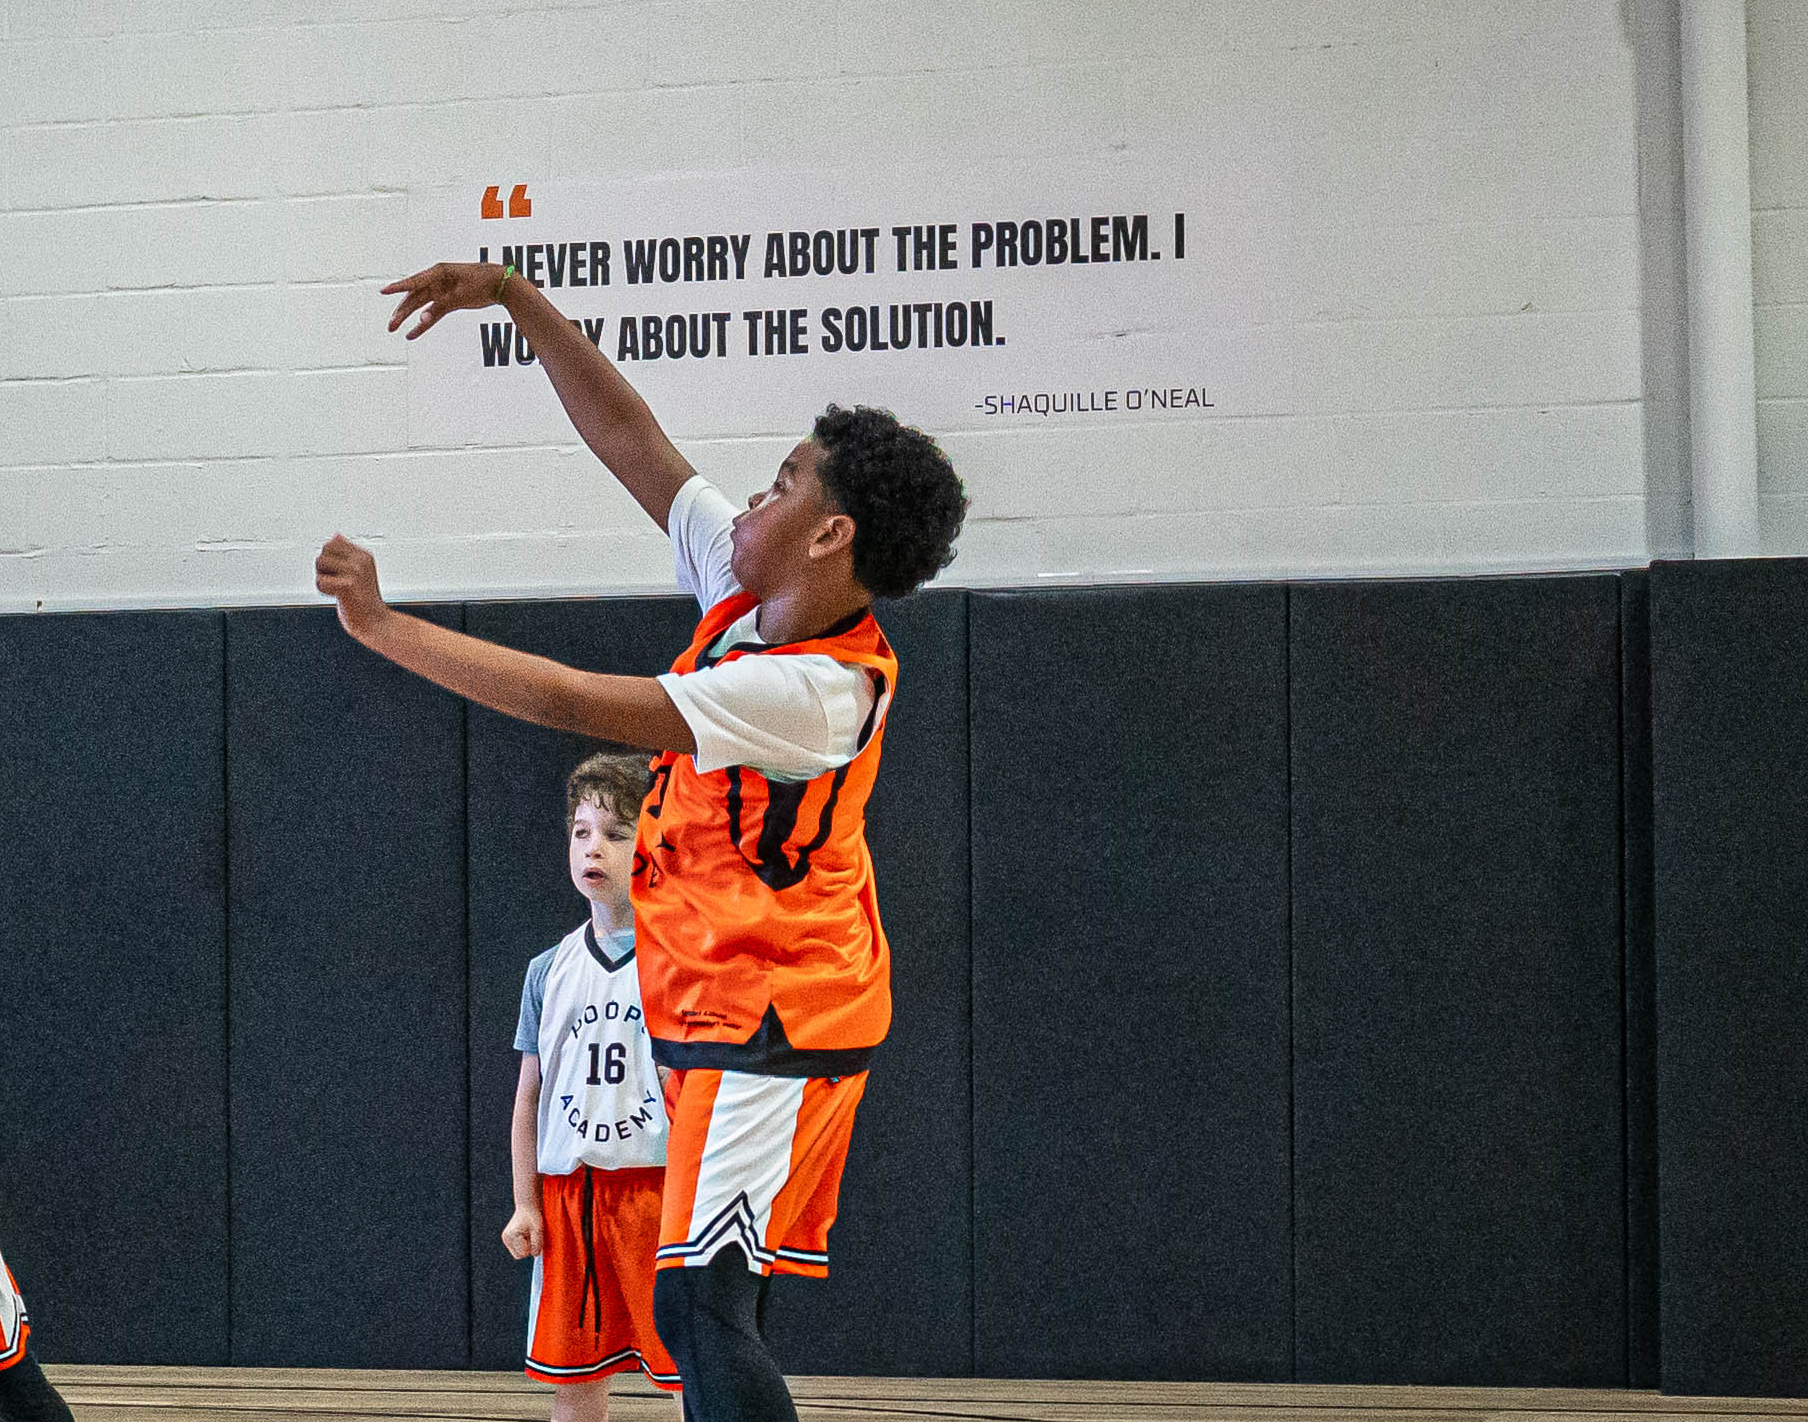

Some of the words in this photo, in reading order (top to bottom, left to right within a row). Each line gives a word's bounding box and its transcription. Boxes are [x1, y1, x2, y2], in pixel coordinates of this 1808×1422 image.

[623, 234, 751, 285] WORRY
[763, 227, 880, 279] ABOUT
[891, 223, 958, 272] THE
[971, 214, 1161, 269] PROBLEM.
[1174, 212, 1185, 259] I
[480, 318, 605, 368] WOY
[616, 312, 732, 362] ABOUT
[742, 307, 809, 357] THE
[821, 300, 1007, 354] SOLUTION.
[974, 391, 1118, 418] -SHAQUILLE
[1125, 387, 1215, 412] O'NEAL
[585, 1042, 627, 1086] 16
[559, 1089, 657, 1143] ACADEMY
